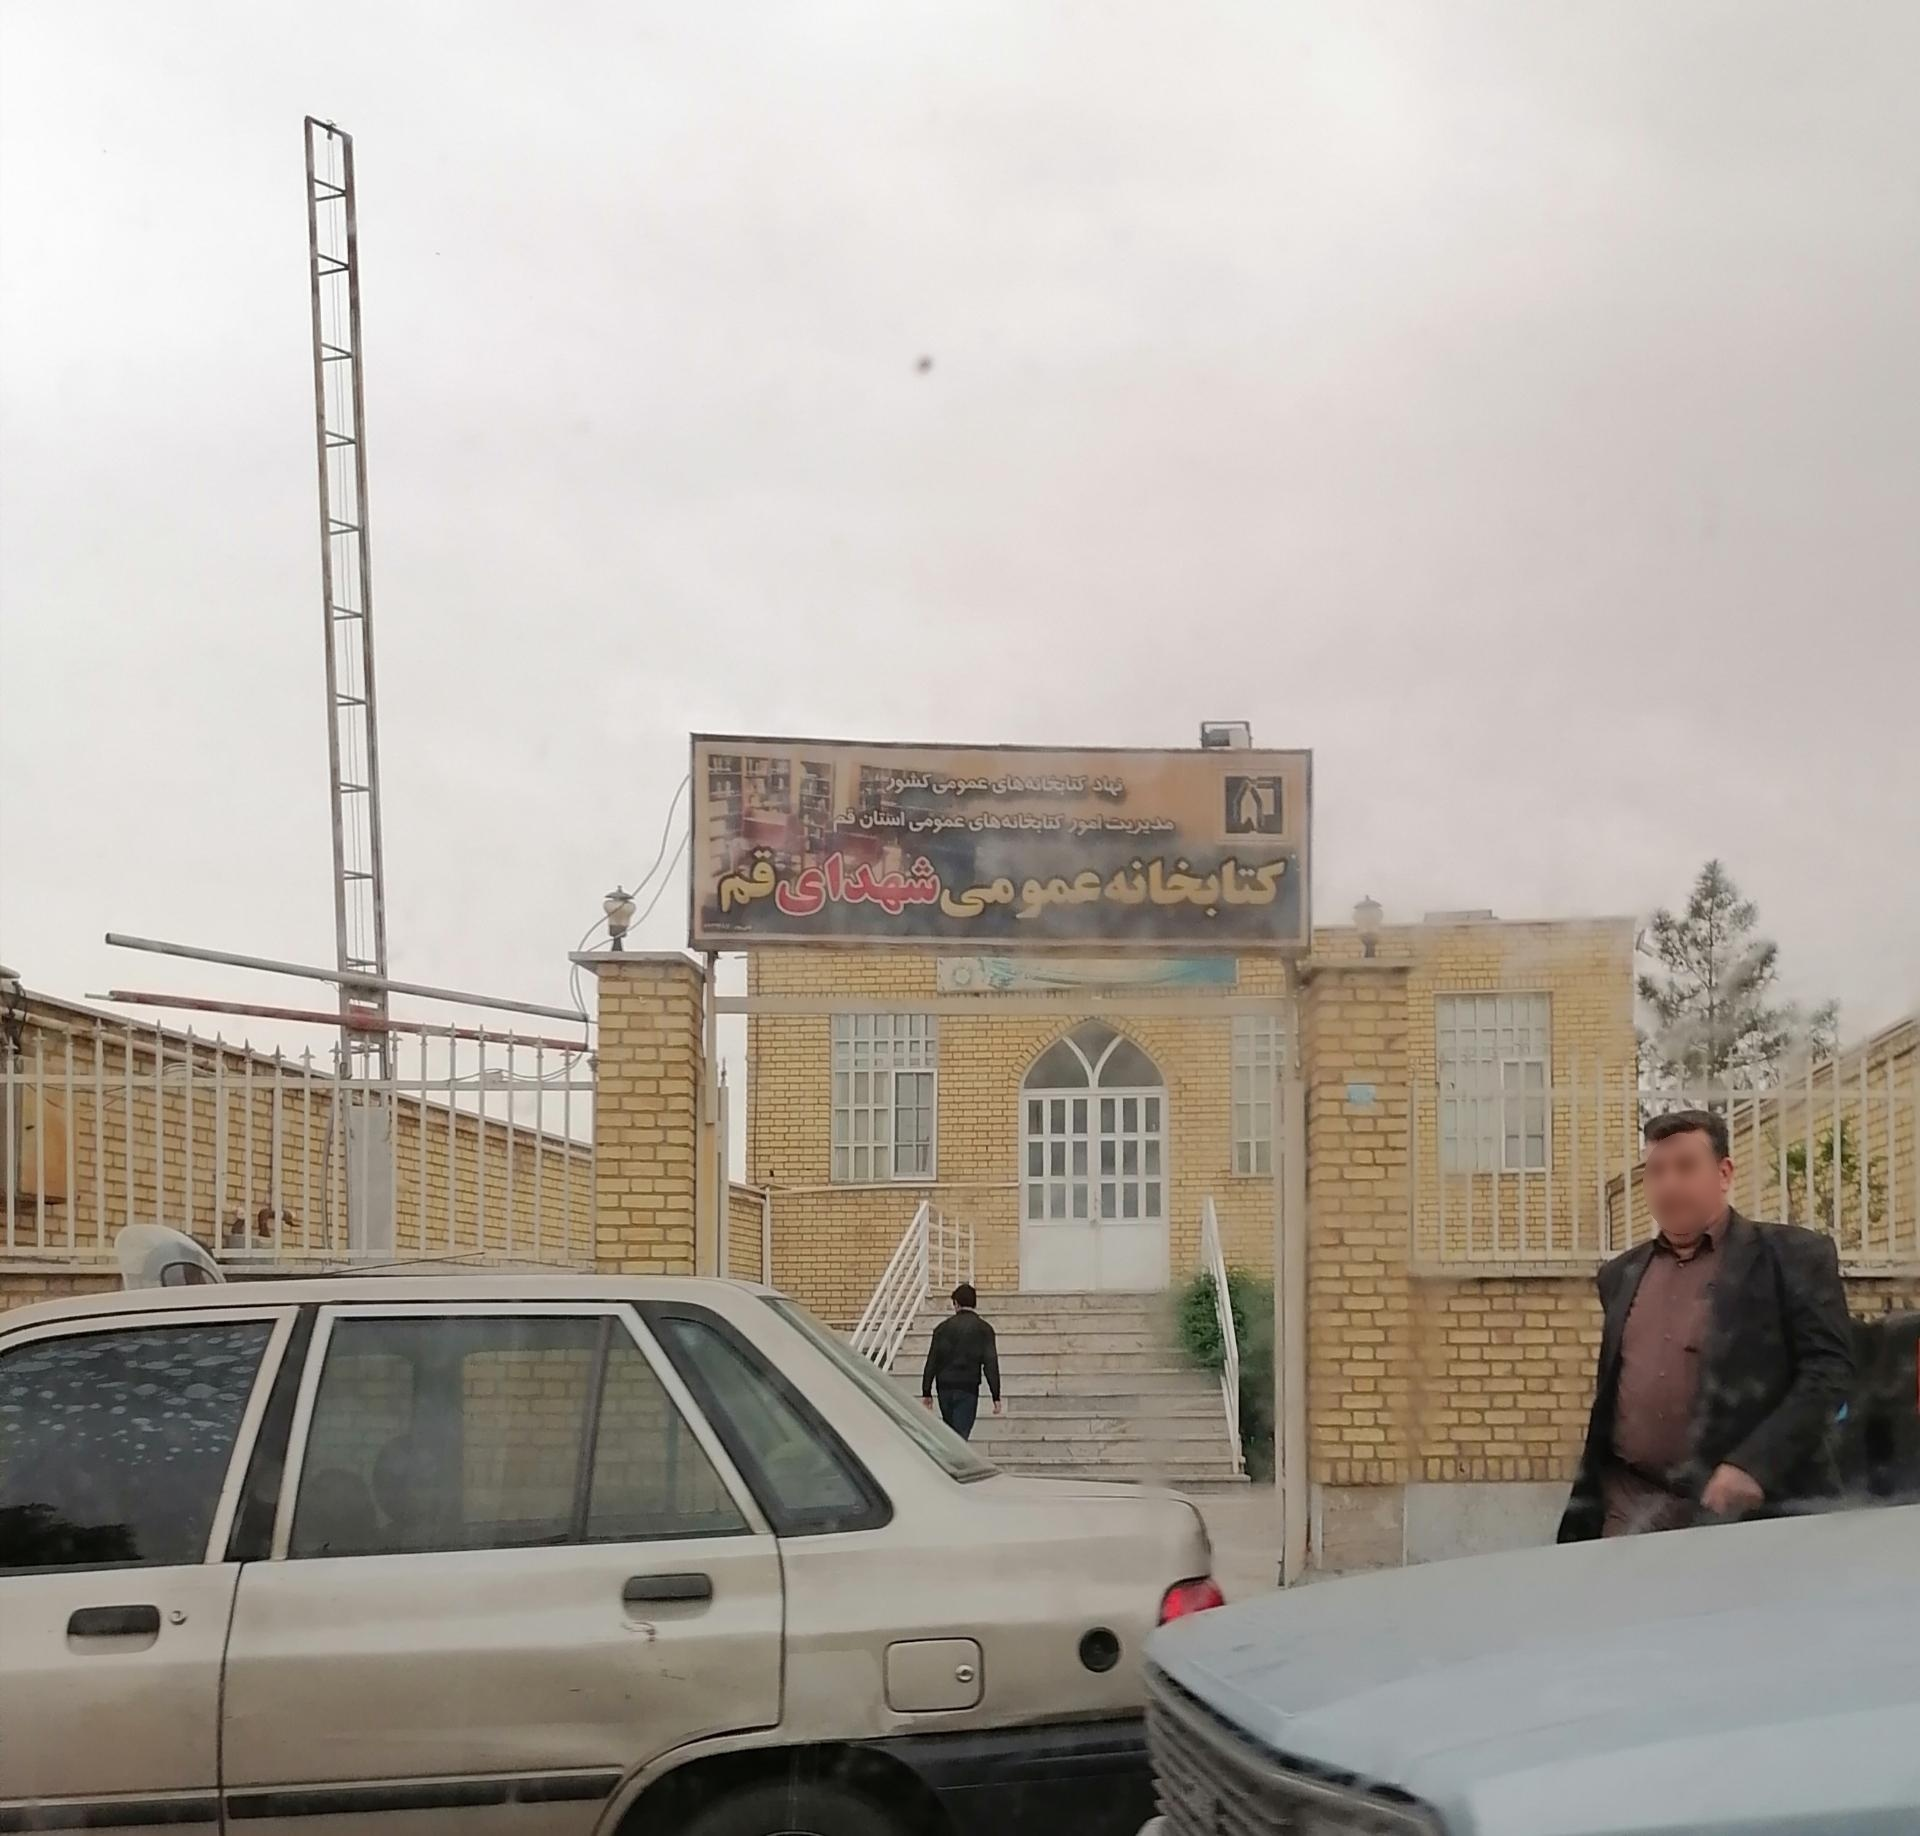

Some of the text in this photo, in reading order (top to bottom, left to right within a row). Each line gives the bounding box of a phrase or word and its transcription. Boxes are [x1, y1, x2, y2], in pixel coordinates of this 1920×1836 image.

[886, 772, 931, 793] کشور
[931, 777, 988, 796] عمومی
[1092, 775, 1124, 797] نهاد
[833, 808, 855, 832] قم
[859, 811, 905, 828] استان
[908, 815, 965, 834] عمومی
[1068, 814, 1103, 836] امور
[1105, 818, 1175, 835] مدیریت
[719, 846, 1286, 918] کتابخانه عمومی شهدای قم
